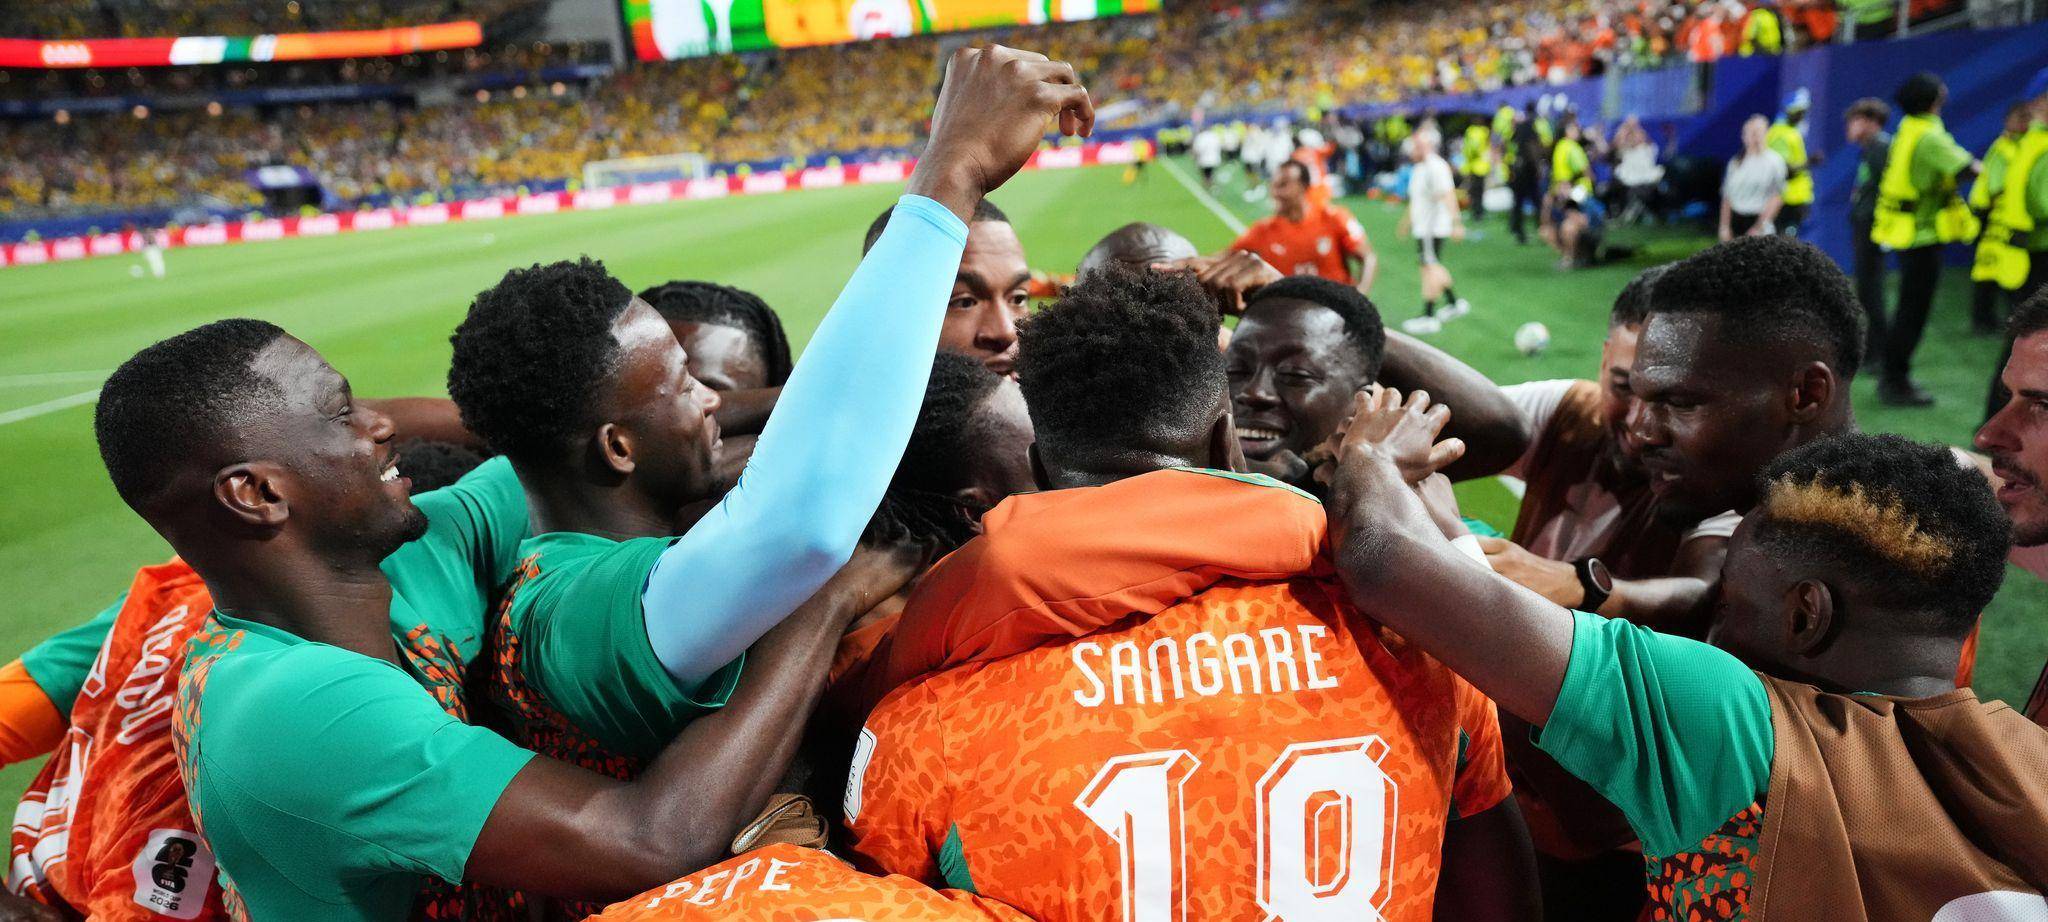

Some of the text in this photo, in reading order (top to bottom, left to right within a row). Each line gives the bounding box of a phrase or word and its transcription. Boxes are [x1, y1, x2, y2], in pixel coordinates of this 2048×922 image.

[1072, 624, 1339, 707] SANGARE
[149, 894, 179, 911] 2026
[646, 857, 802, 908] PEPE
